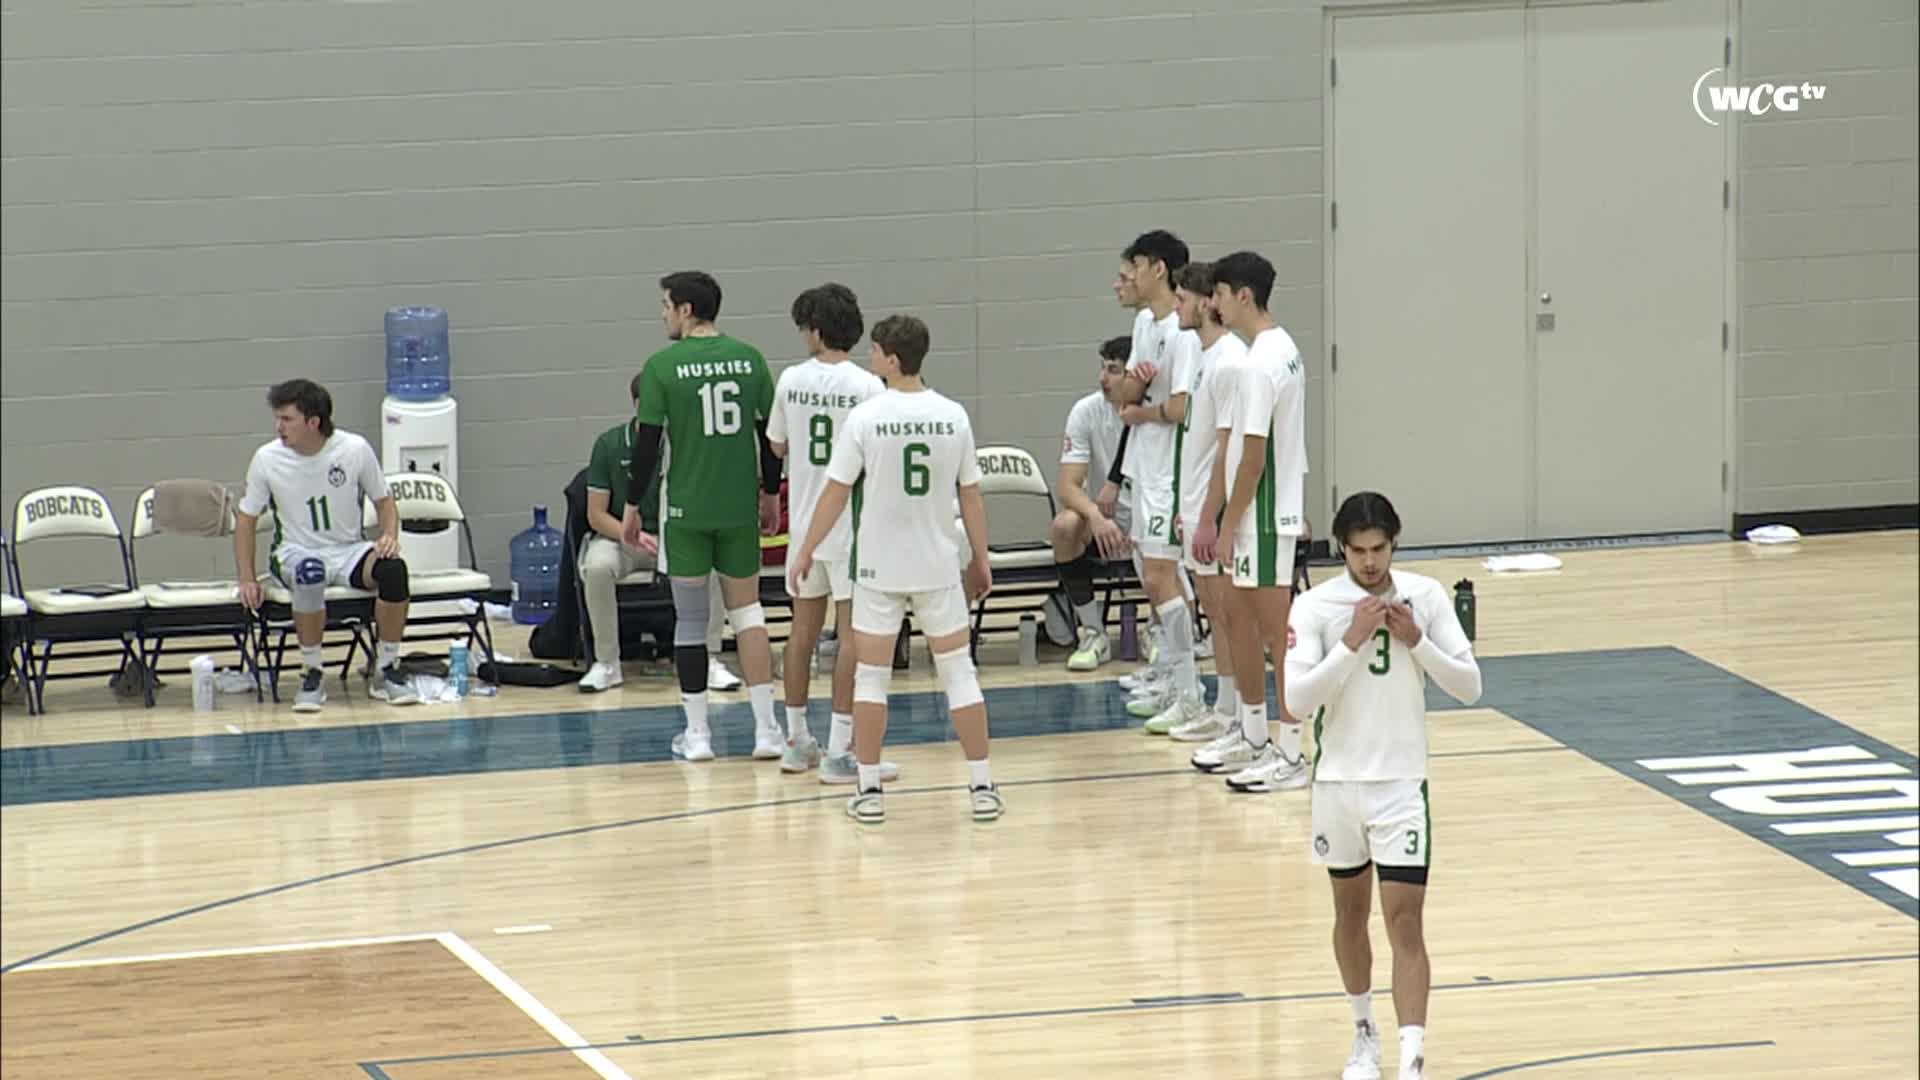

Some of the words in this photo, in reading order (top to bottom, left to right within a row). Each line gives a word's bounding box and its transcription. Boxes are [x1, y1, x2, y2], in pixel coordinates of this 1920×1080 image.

[676, 359, 752, 379] HUSKIES
[698, 380, 742, 437] 16
[788, 389, 857, 408] HUSKIES
[808, 413, 833, 466] 8
[876, 422, 955, 437] HUSKIES
[903, 442, 931, 496] 6
[977, 455, 1033, 477] BCATS
[388, 480, 447, 503] BCATS
[24, 495, 103, 523] BOBCATS
[306, 495, 332, 531] 11
[1148, 515, 1164, 537] 12
[1234, 555, 1251, 577] 14
[1368, 627, 1391, 675] 3
[1634, 744, 1919, 900] HOM
[1404, 829, 1419, 856] 3
